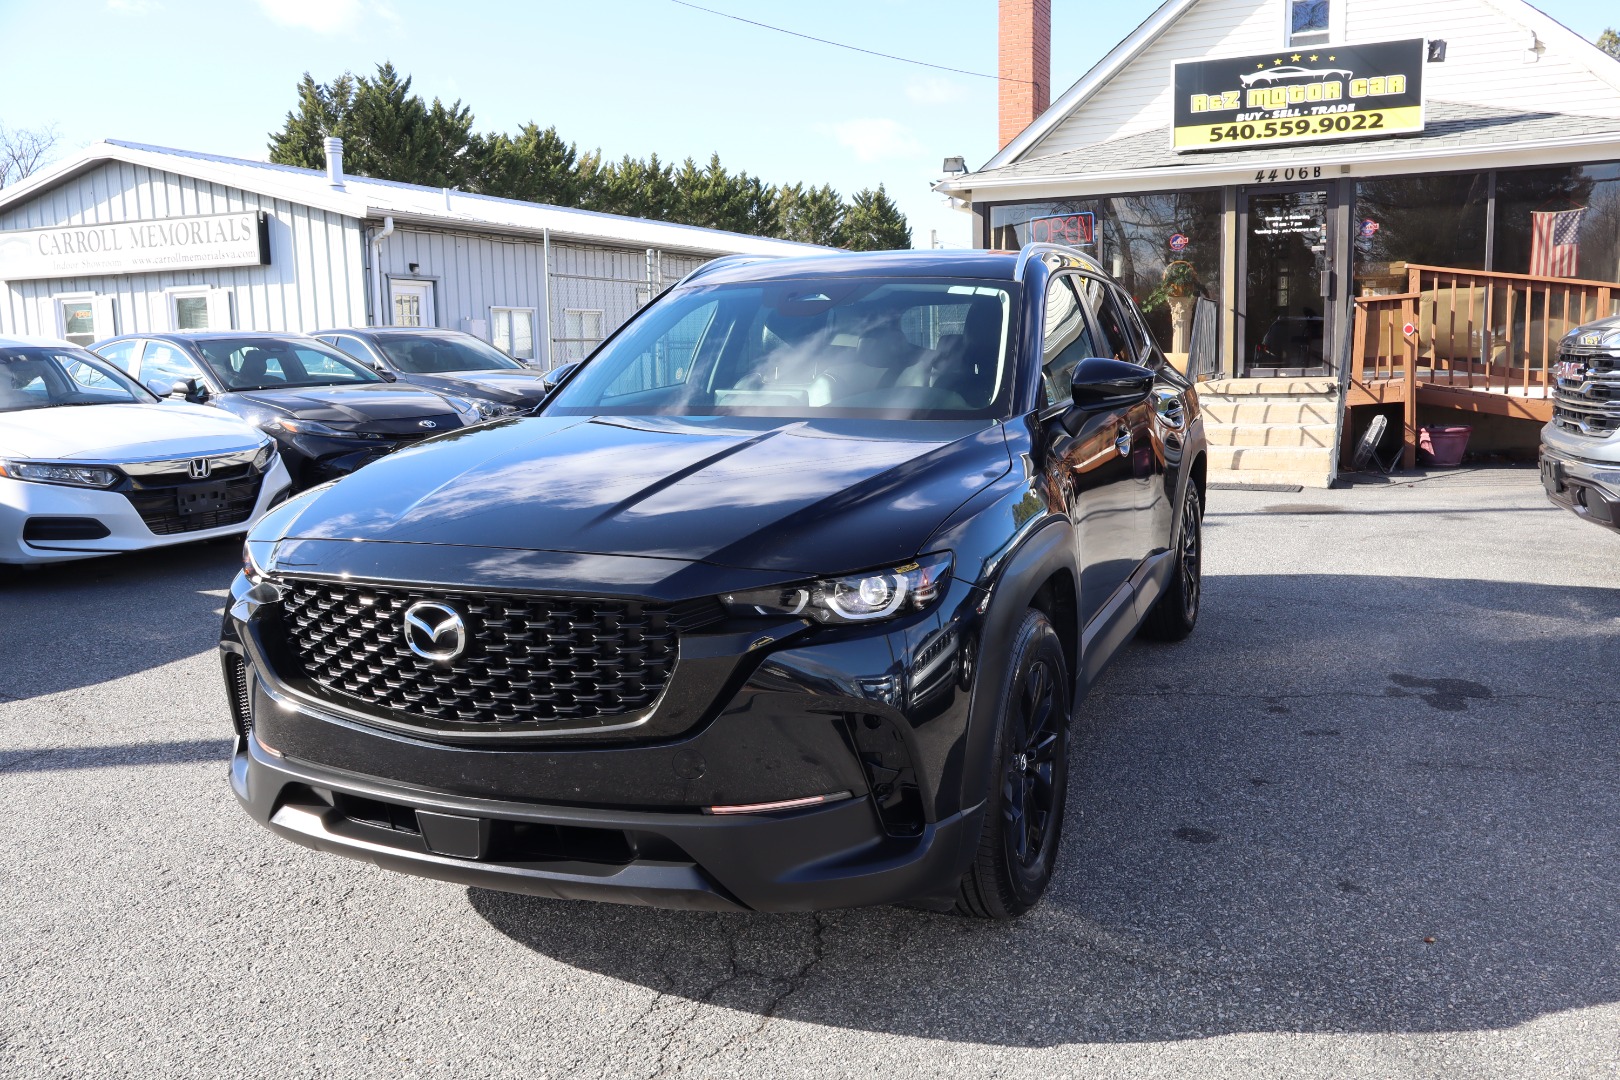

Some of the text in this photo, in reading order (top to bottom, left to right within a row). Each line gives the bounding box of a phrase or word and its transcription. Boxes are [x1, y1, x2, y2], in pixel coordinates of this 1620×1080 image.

[1190, 90, 1240, 113] A&Z
[1235, 103, 1356, 122] BUY SELL TRADE
[1209, 113, 1384, 142] 540.559.9022
[38, 217, 251, 256] CARROLL MEMORIALS
[1033, 216, 1092, 243] OPEN
[53, 249, 256, 270] Indoor Showroom www.carrollmemorialsva.com
